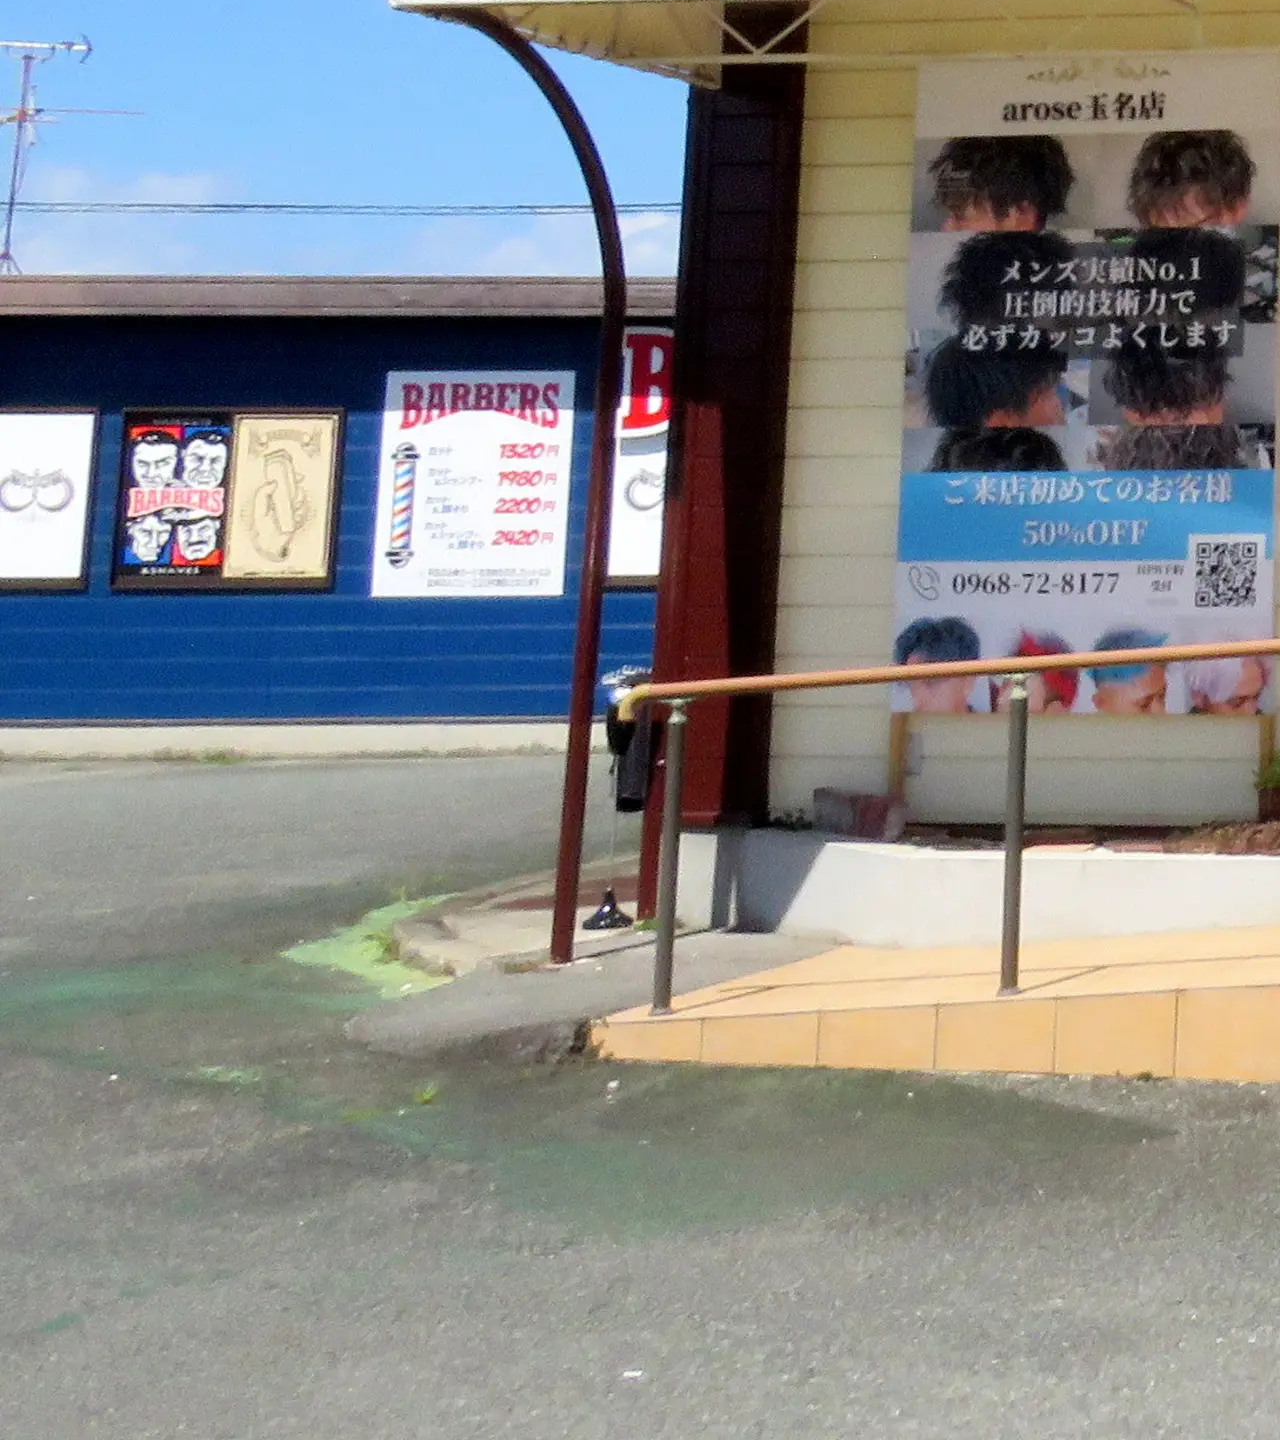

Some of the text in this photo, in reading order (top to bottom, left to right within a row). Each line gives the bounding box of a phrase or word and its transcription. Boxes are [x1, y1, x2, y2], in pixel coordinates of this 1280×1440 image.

[1003, 288, 1196, 318] 圧倒的技術力で
[961, 319, 1237, 351] 必ずカッコよくします
[400, 382, 560, 430] BARBERS
[133, 489, 223, 514] BARBERS
[944, 472, 1233, 505] ご来店初めてのお客様
[1022, 519, 1149, 546] 50%OFF
[951, 571, 1120, 595] 0968-72-8177
